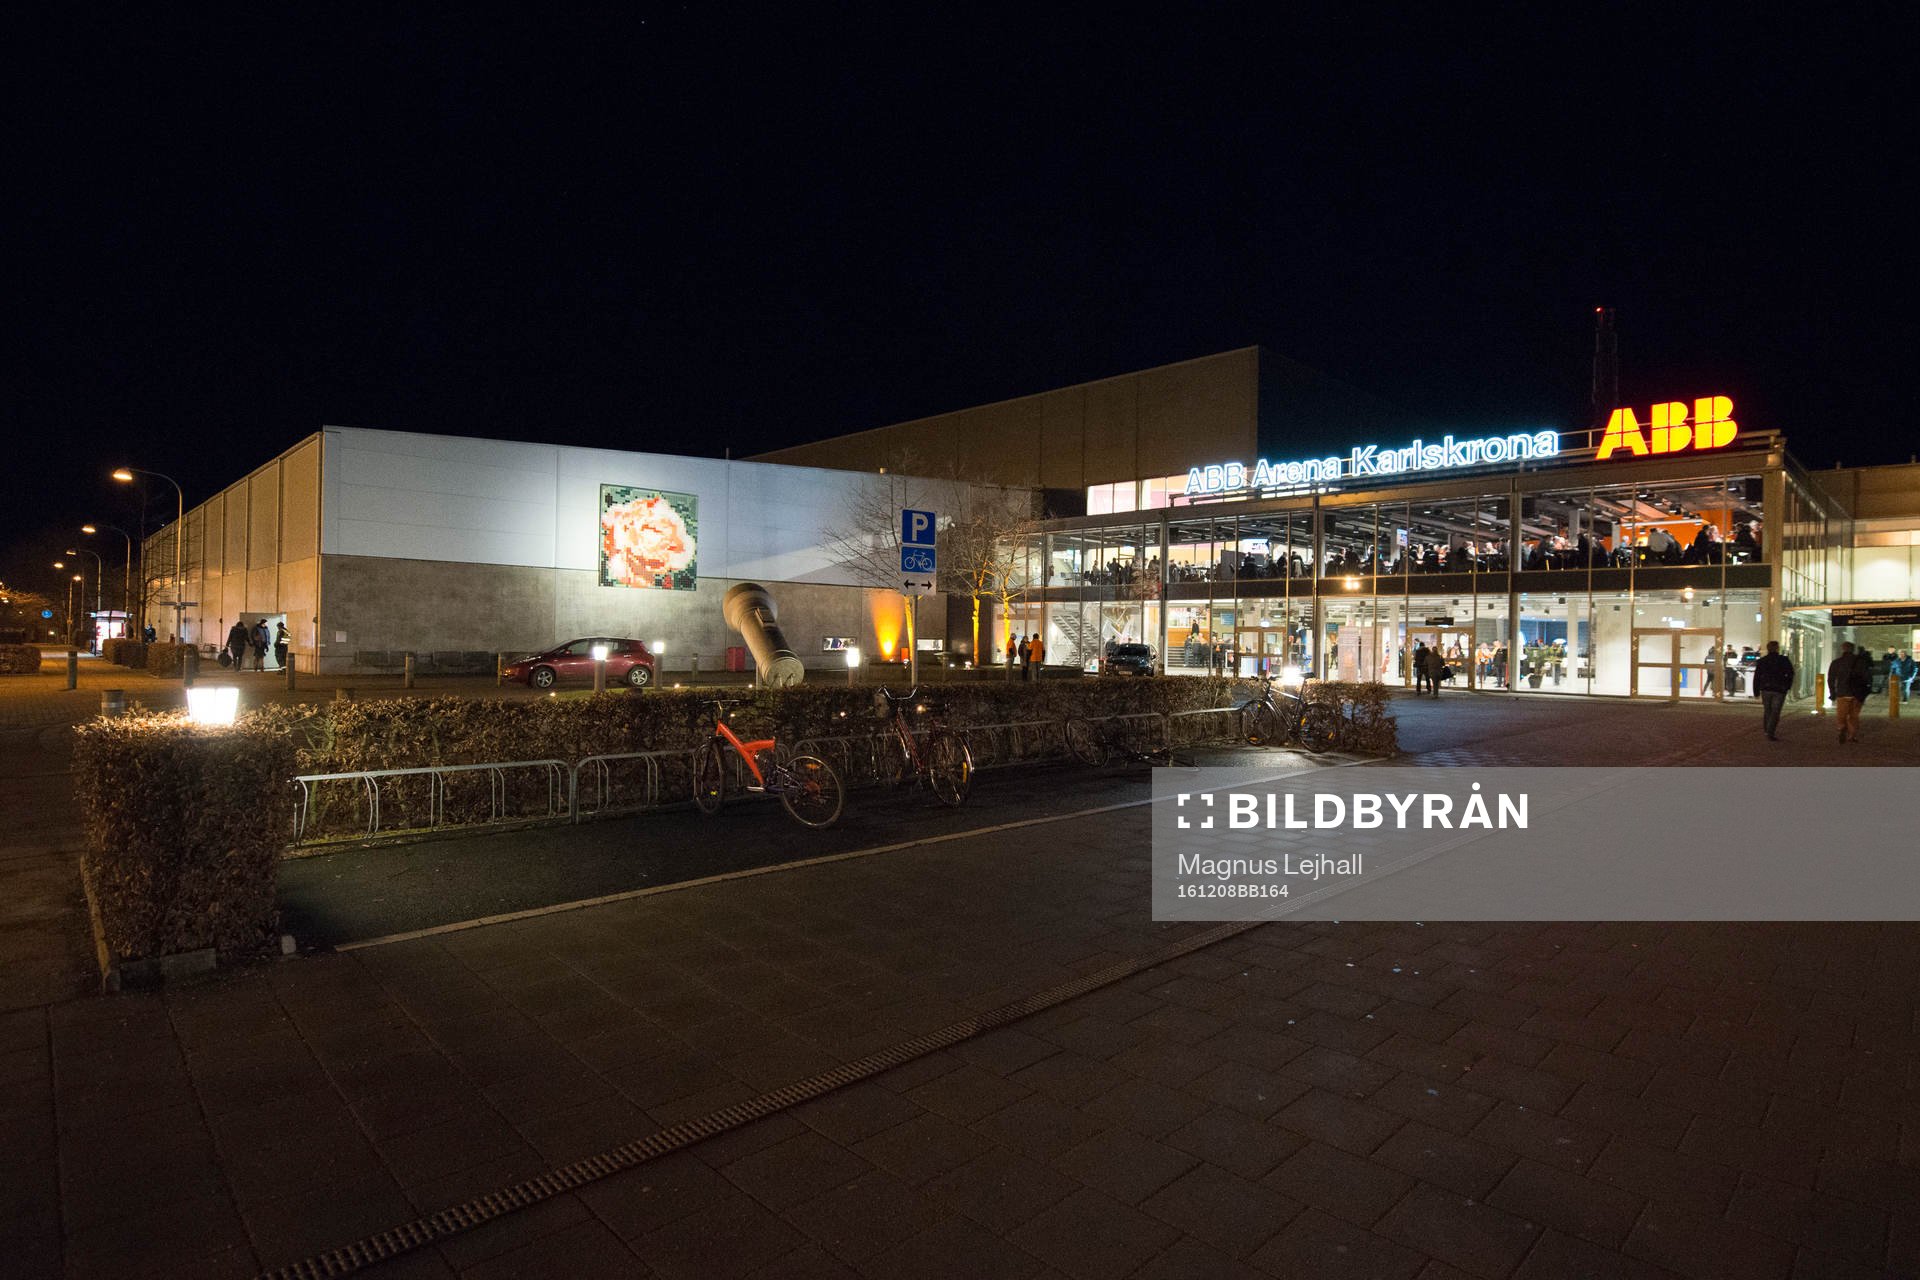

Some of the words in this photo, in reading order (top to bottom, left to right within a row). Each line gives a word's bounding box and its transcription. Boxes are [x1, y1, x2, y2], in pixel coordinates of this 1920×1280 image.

[1595, 395, 1738, 461] ABB
[1185, 462, 1244, 496] ABB
[1250, 455, 1341, 488] Arena
[1350, 429, 1559, 477] Karlskrona
[911, 512, 929, 542] P
